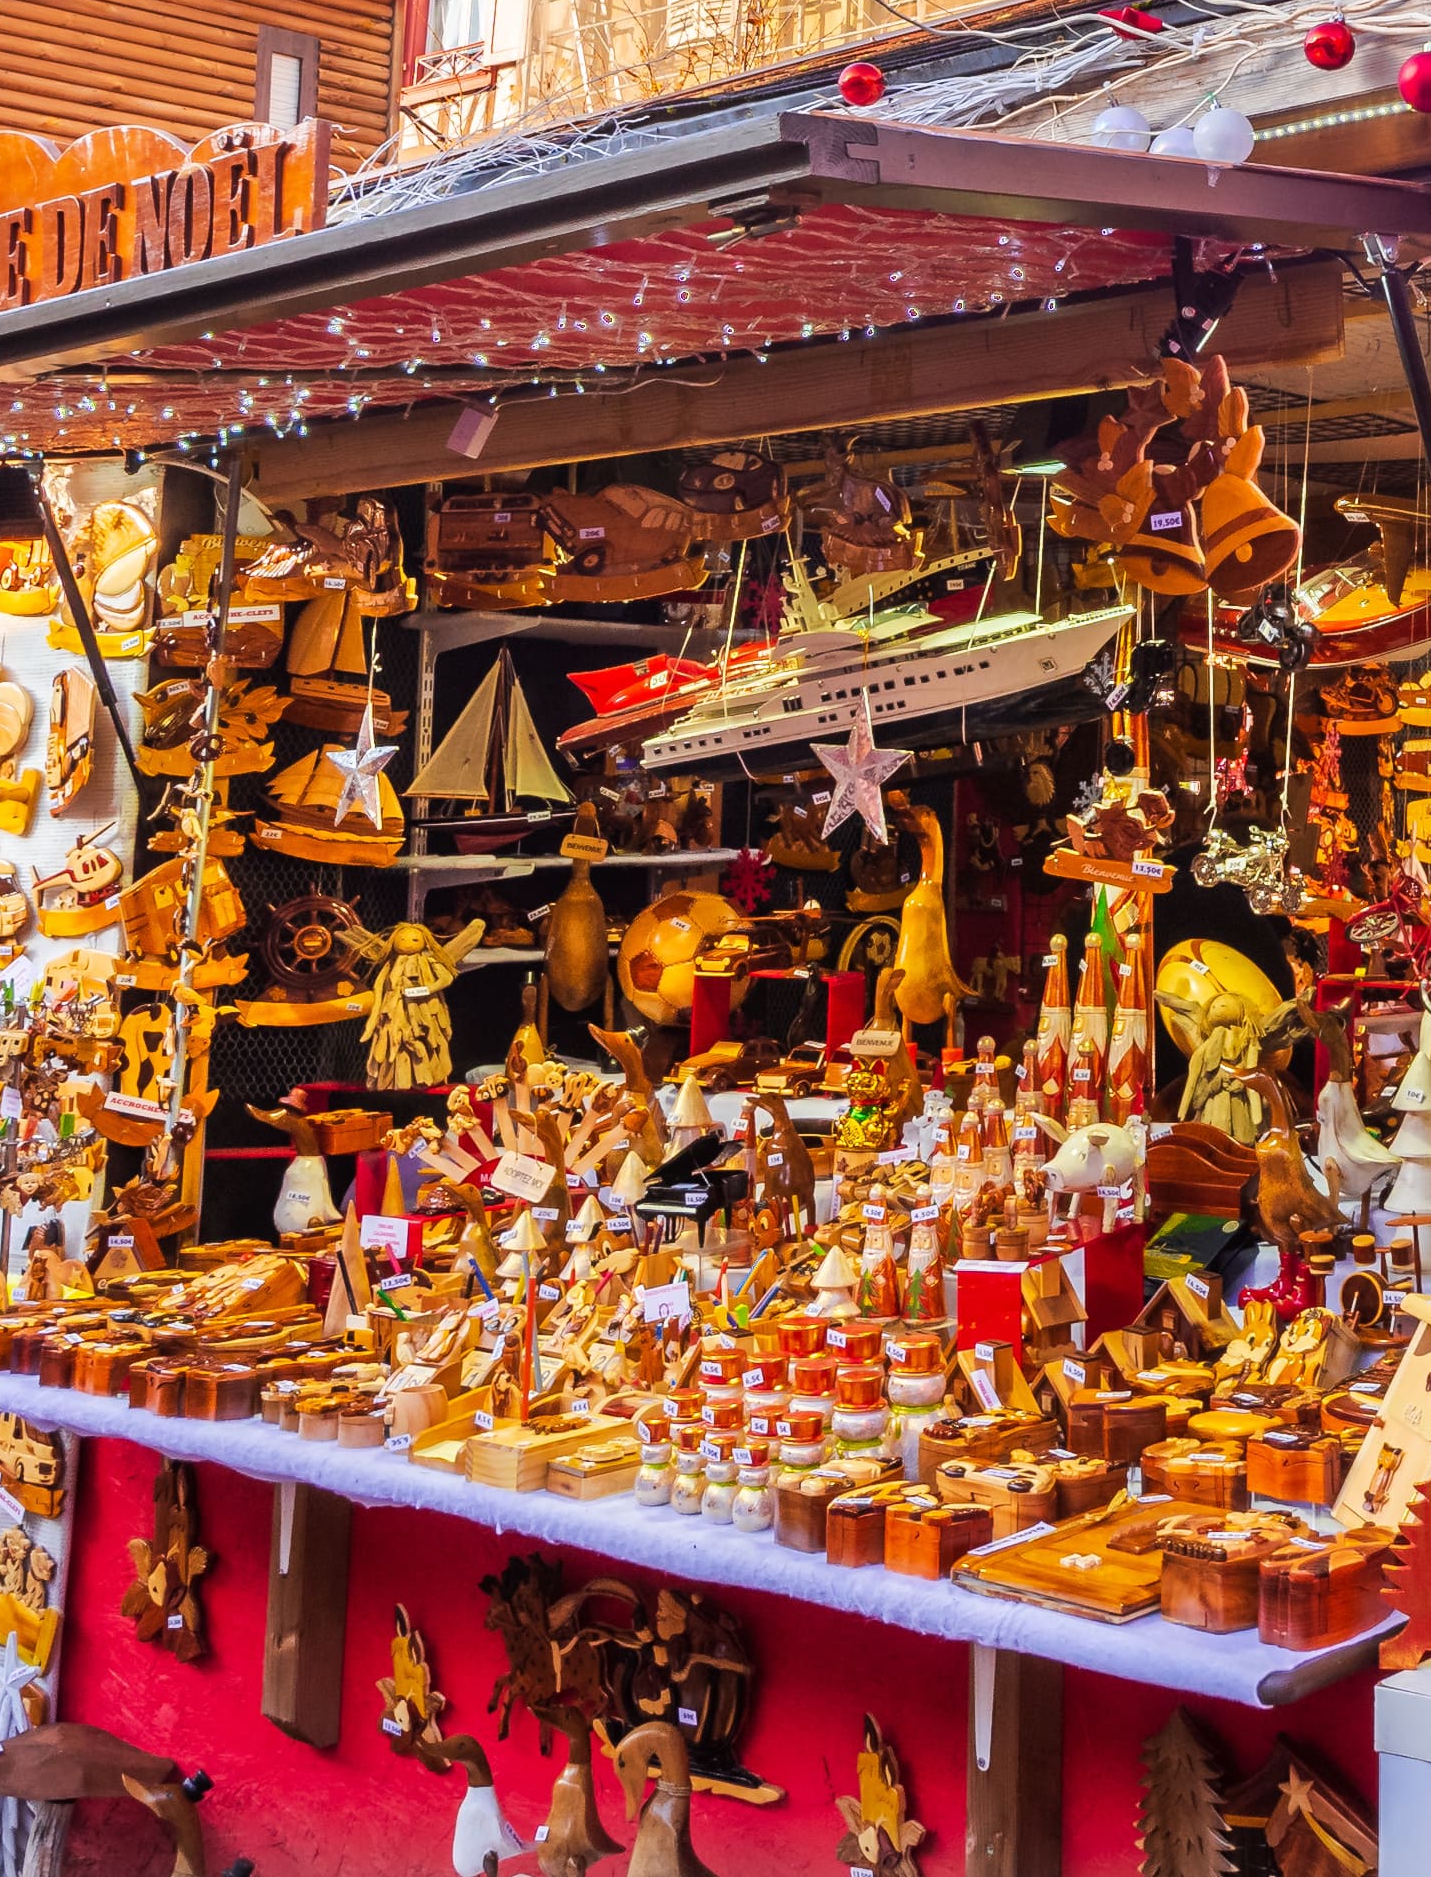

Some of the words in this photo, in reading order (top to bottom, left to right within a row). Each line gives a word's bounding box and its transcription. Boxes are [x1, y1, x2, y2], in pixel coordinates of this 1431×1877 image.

[35, 181, 124, 302] DE
[131, 130, 306, 282] NOËL
[1153, 516, 1180, 528] 19,50€
[856, 1038, 894, 1047] BIENVENUE
[504, 1164, 530, 1185] ADOPTEZ
[914, 1210, 936, 1219] 4,50€
[1384, 1295, 1403, 1303] 34,50
[704, 1365, 719, 1373] 6,5€
[745, 1375, 760, 1384] 6,5€
[704, 1411, 713, 1419] 5€
[754, 1423, 765, 1431] 5€
